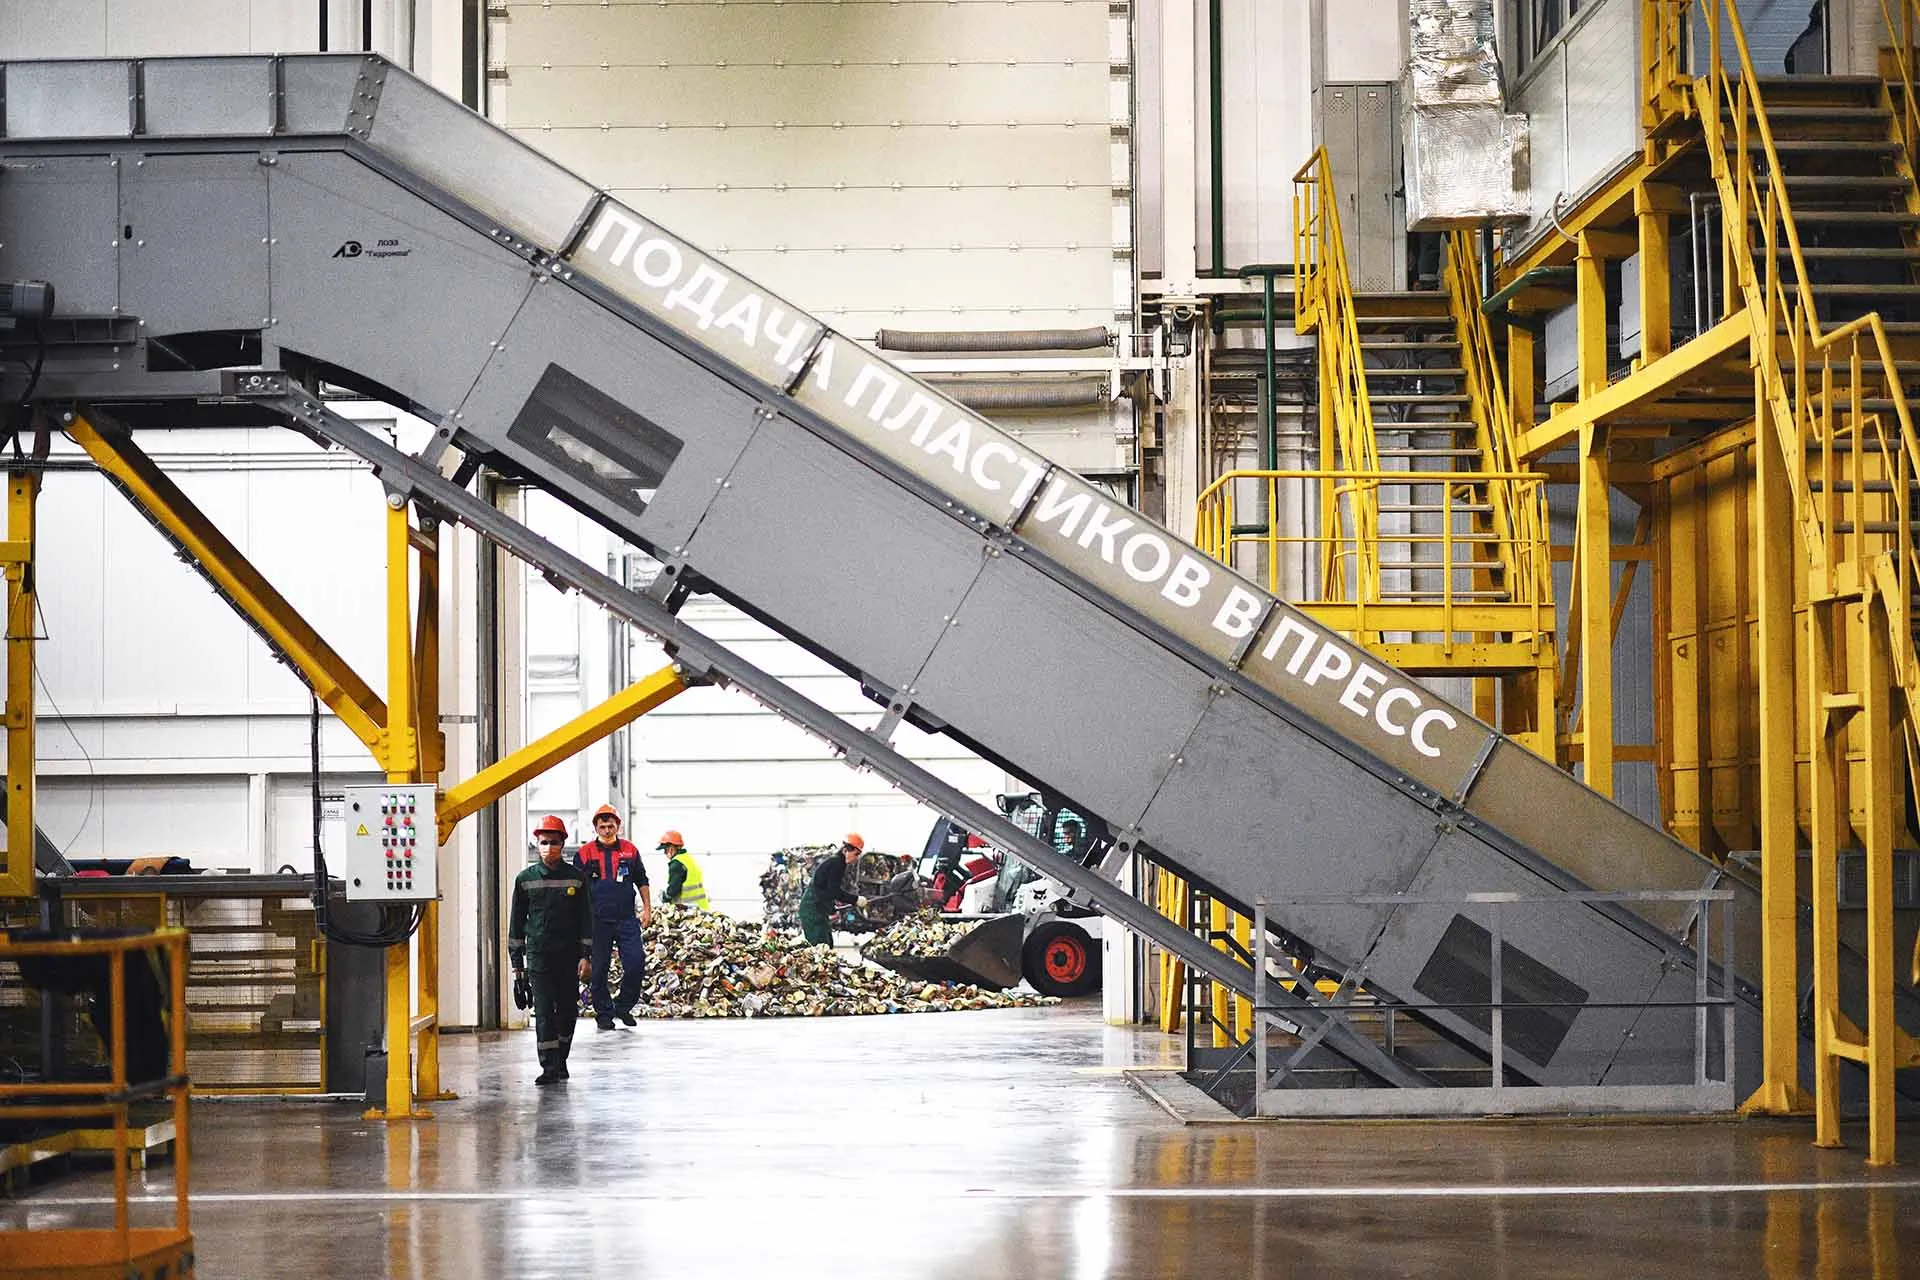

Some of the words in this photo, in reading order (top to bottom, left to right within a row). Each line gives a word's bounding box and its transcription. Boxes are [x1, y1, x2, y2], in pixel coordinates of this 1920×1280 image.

[585, 206, 835, 391] ПОДАЧА
[844, 366, 1211, 608] ПЛАСТИКОВ
[1211, 584, 1262, 639] В
[1262, 615, 1457, 757] ПРЕСС
